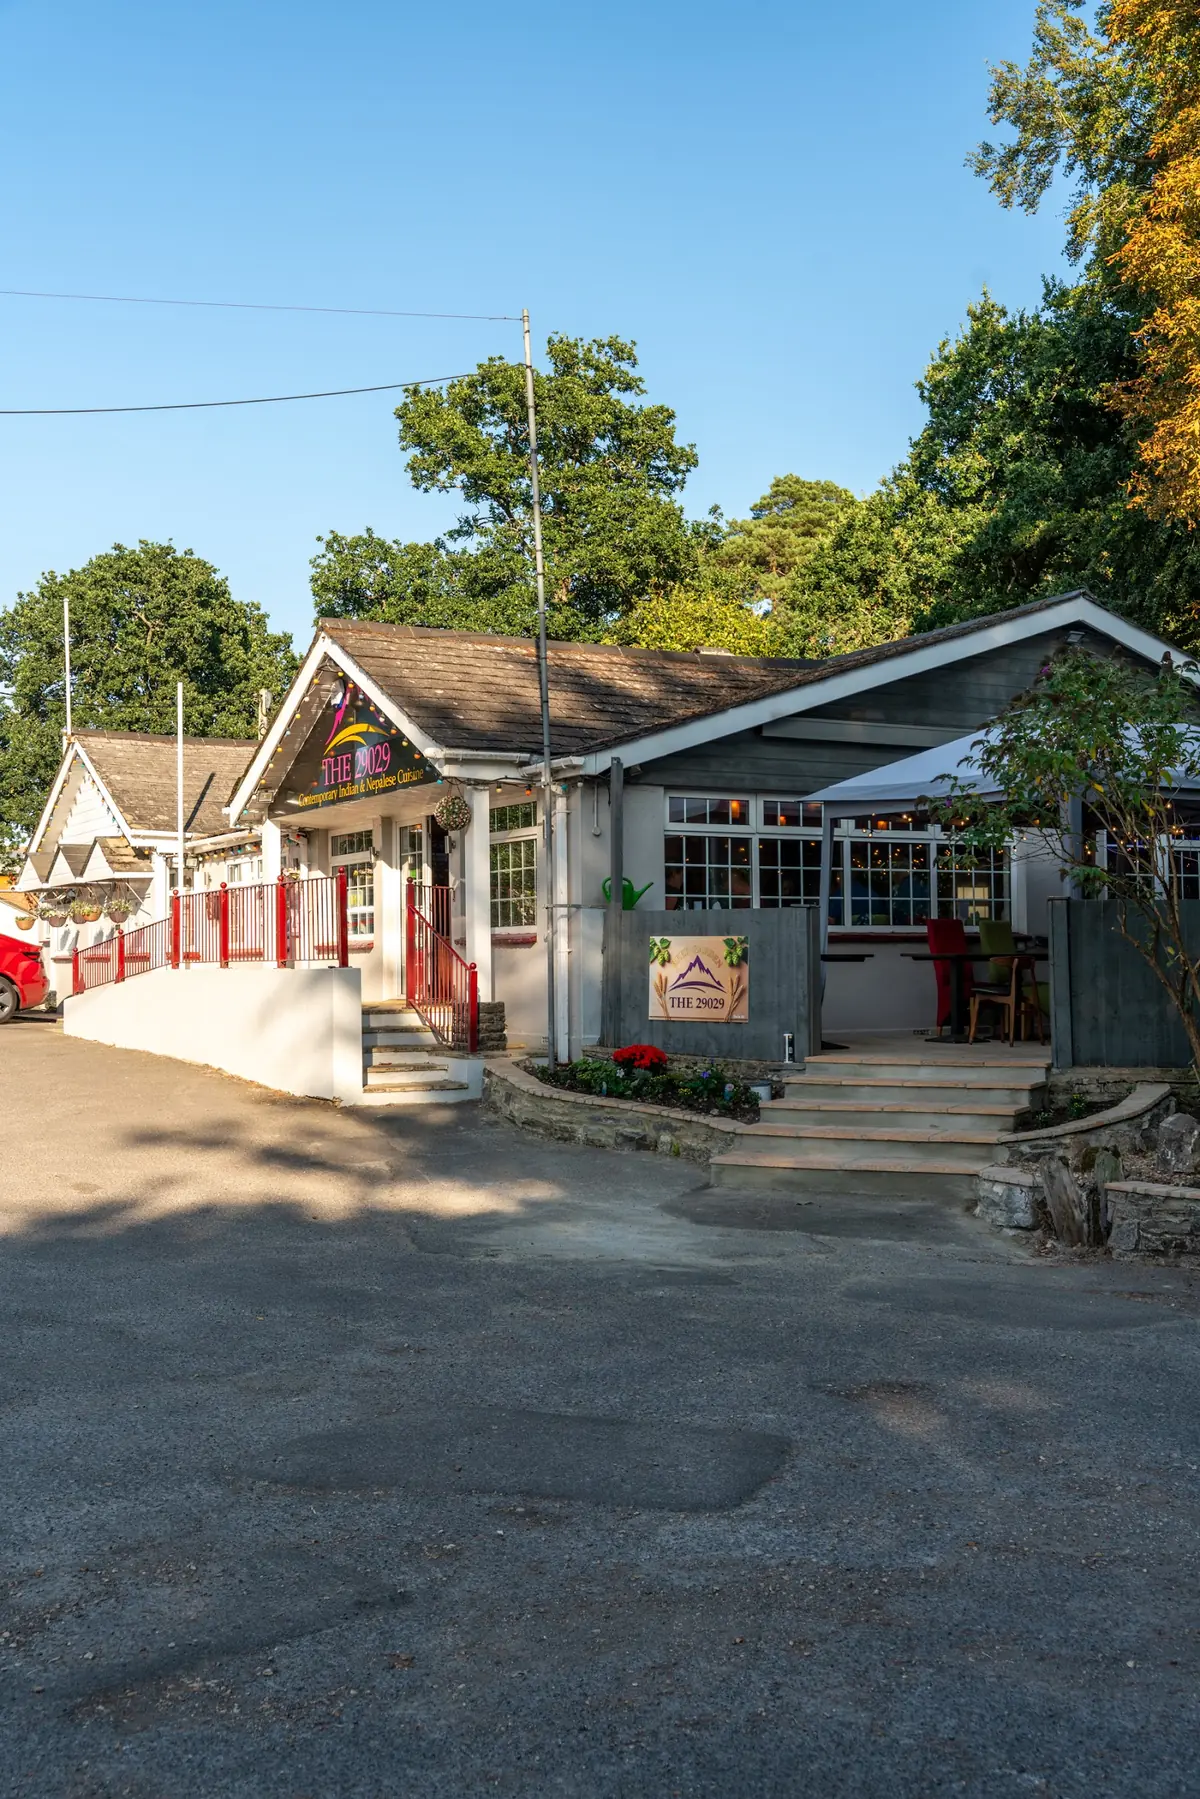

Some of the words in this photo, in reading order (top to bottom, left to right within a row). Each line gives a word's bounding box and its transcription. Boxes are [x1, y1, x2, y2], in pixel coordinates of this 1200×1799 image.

[322, 754, 352, 786] THE
[355, 742, 391, 779] 29029
[298, 790, 337, 807] Contemporary
[338, 783, 359, 798] Indian
[359, 781, 366, 793] &
[366, 773, 396, 794] Nepalese
[397, 768, 424, 784] Cuisine
[669, 996, 693, 1009] THE
[696, 997, 725, 1009] 29029
